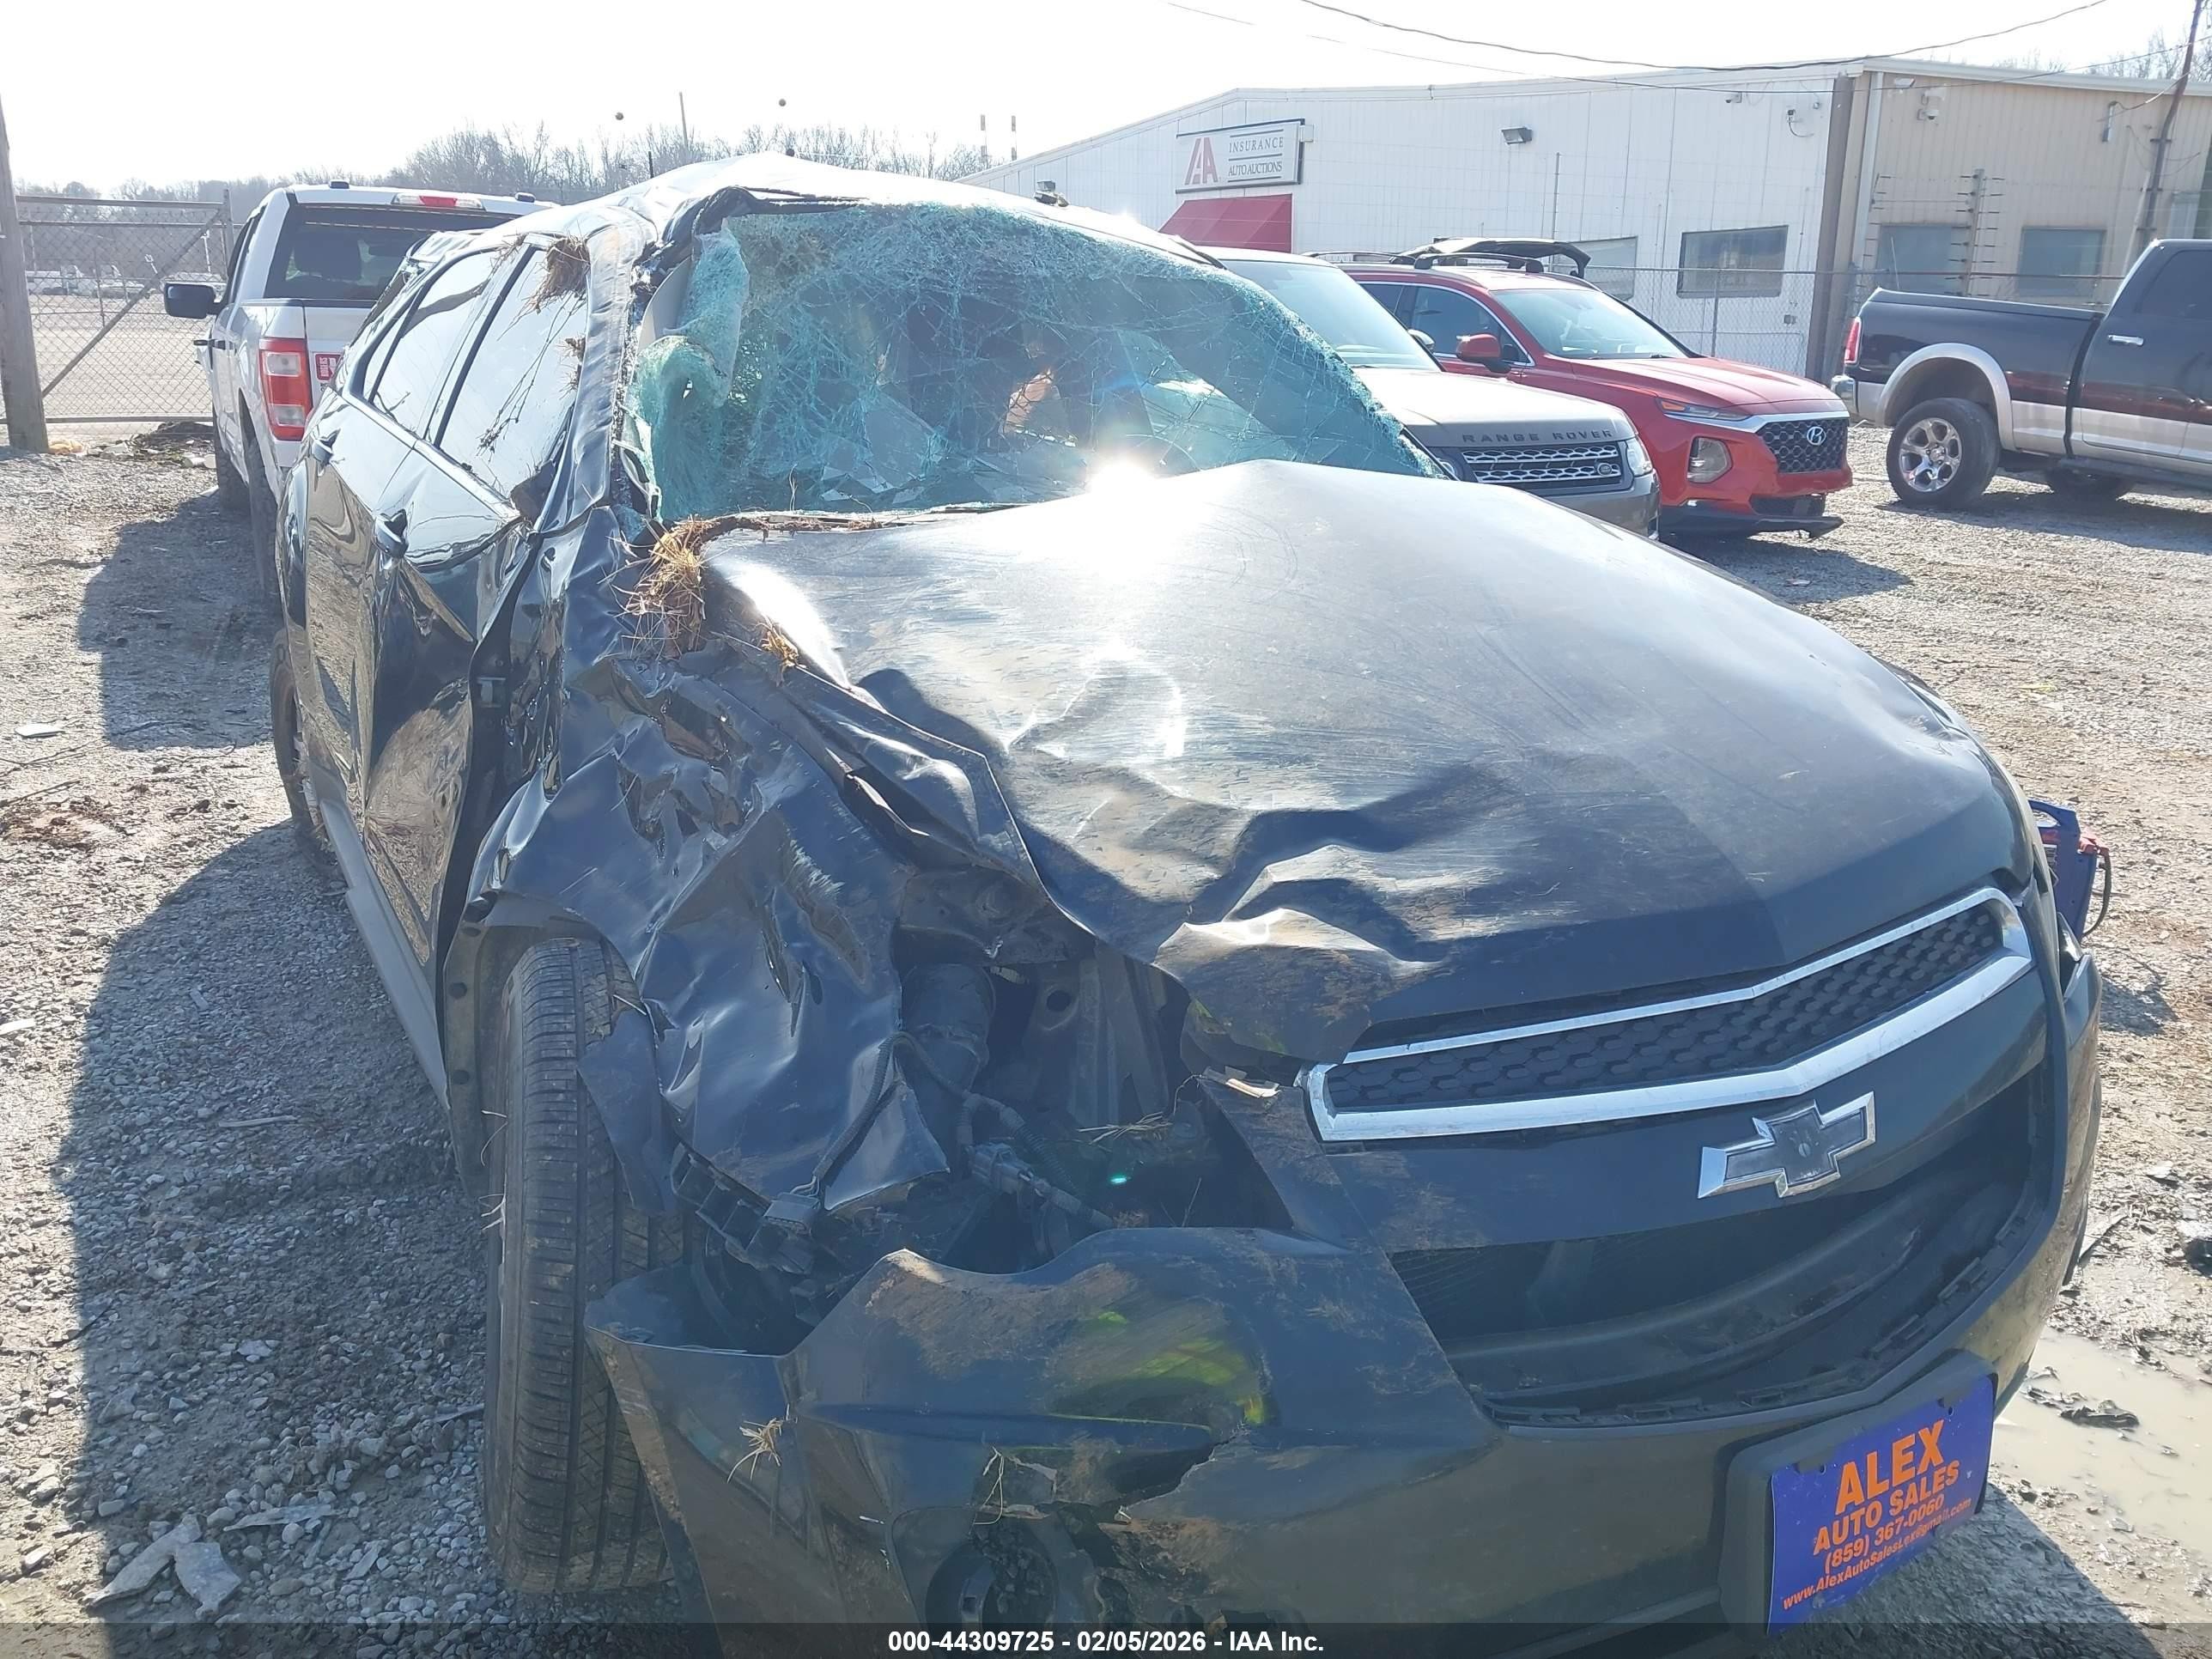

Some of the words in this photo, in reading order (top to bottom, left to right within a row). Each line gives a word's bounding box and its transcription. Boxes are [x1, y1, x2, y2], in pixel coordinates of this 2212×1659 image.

[1228, 164, 1247, 177] AUTO
[1248, 161, 1283, 175] AUCTIONS
[1229, 137, 1284, 153] INSURANCE
[1462, 433, 1540, 443] RANGE
[1552, 429, 1613, 441] ROVER
[1834, 1419, 1945, 1516] ALEX
[1813, 1500, 1883, 1557] AUTO
[1889, 1460, 1960, 1516] SALES
[1825, 1534, 1870, 1575] (859)
[1875, 1493, 1945, 1547] 367-0060
